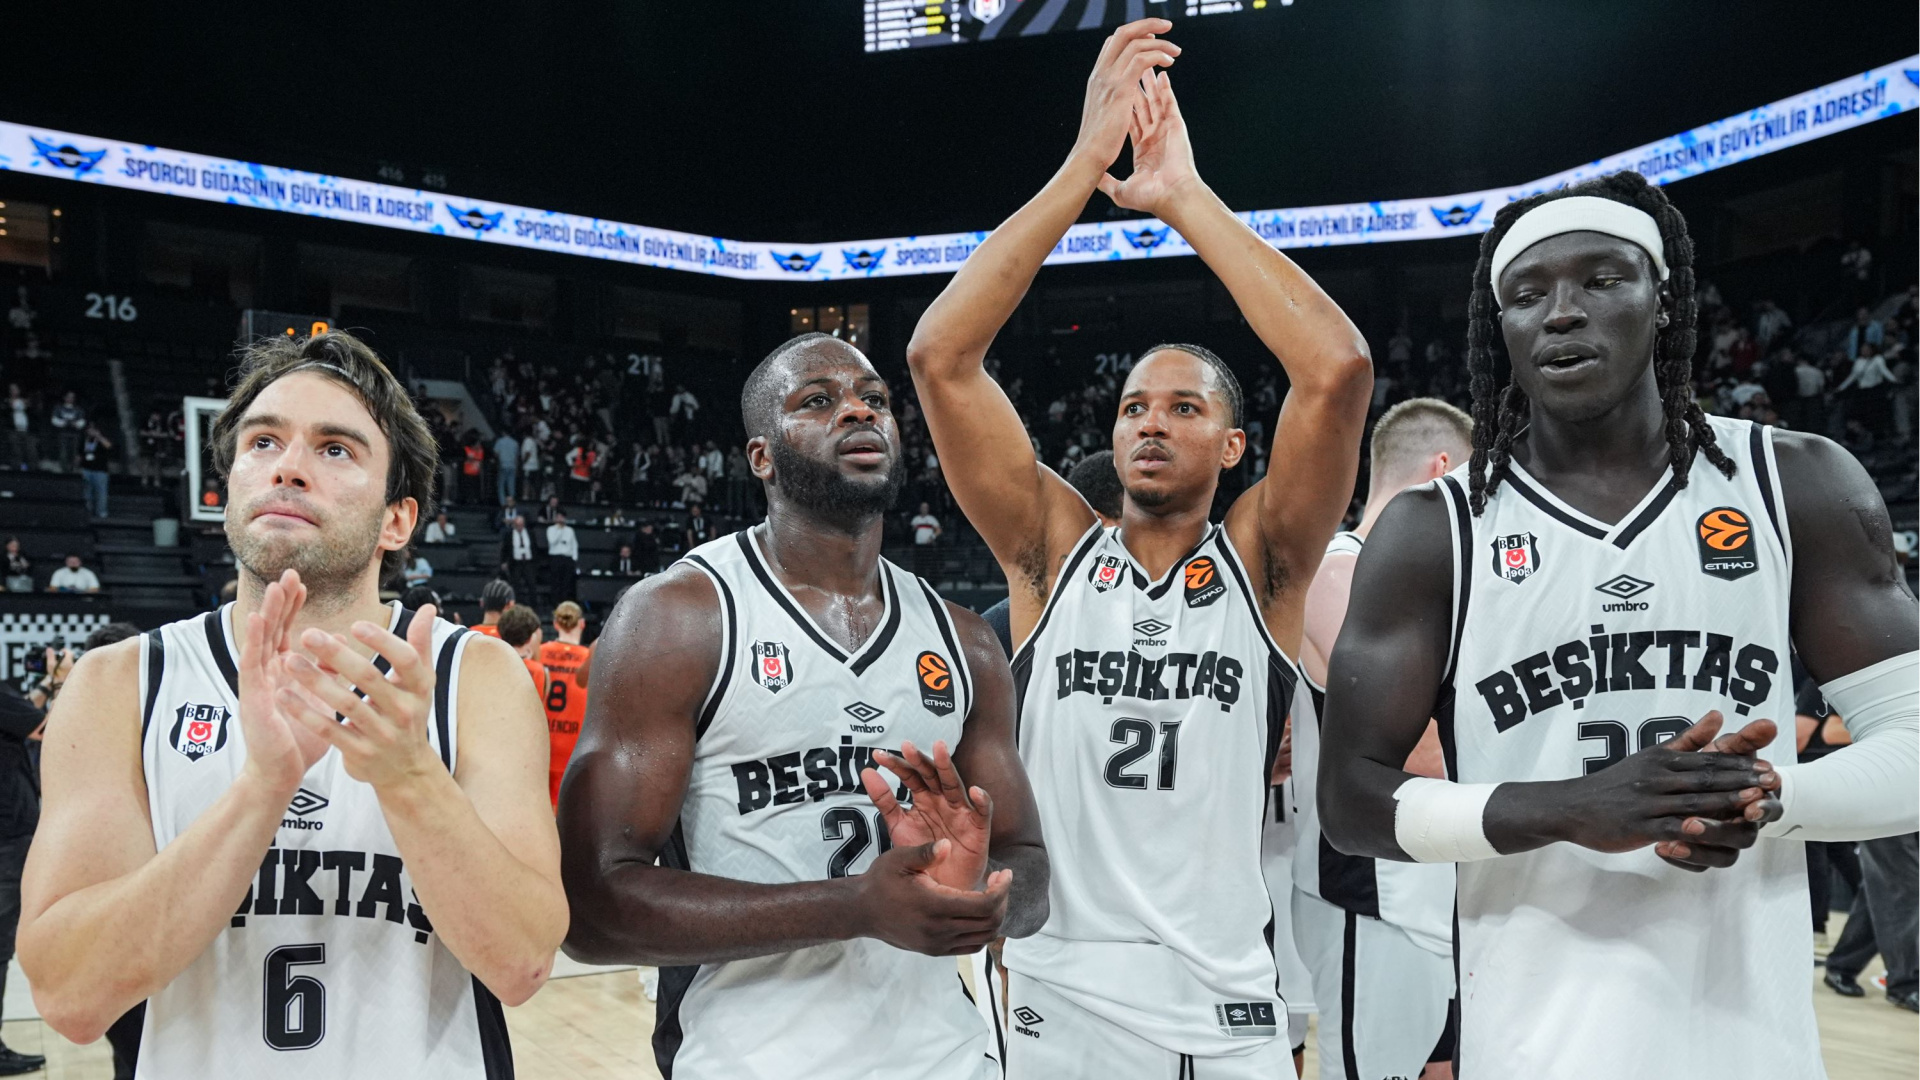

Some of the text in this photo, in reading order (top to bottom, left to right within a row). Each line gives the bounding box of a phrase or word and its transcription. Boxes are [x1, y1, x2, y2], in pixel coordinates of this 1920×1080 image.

[1638, 80, 1887, 176] GIDASININ GÜVENİLİR ADRESİ!
[125, 157, 434, 223] SPORCU GIDASININ GÜVENİLİR ADRESİ!
[1300, 213, 1364, 237] GÜVENİLİR
[515, 219, 758, 270] SPORCU GIDASININ GÜVENİLİR ADRESİ!
[897, 244, 979, 266] SPORCU GIDA
[85, 293, 137, 321] 216
[627, 353, 654, 376] 21
[1500, 535, 1530, 549] BJK
[1505, 567, 1532, 579] 1903
[1704, 560, 1755, 571] ETIHAD
[1190, 586, 1224, 605] ETIHAD
[1602, 600, 1649, 613] umbro
[757, 644, 784, 656] BJK
[762, 678, 787, 688] 1903
[1056, 645, 1243, 713] BEŞİKTAŞ
[1475, 623, 1779, 734] BEŞİKTAŞ
[547, 681, 567, 712] 8
[924, 698, 953, 709] ETIHAD
[186, 707, 223, 720] BJK
[548, 719, 580, 734] ENCIA
[849, 723, 885, 734] umbro
[182, 744, 213, 754] 1903
[1103, 717, 1182, 790] 21
[280, 817, 324, 831] mbro
[263, 943, 326, 1051] 6
[1014, 1024, 1040, 1039] umbro
